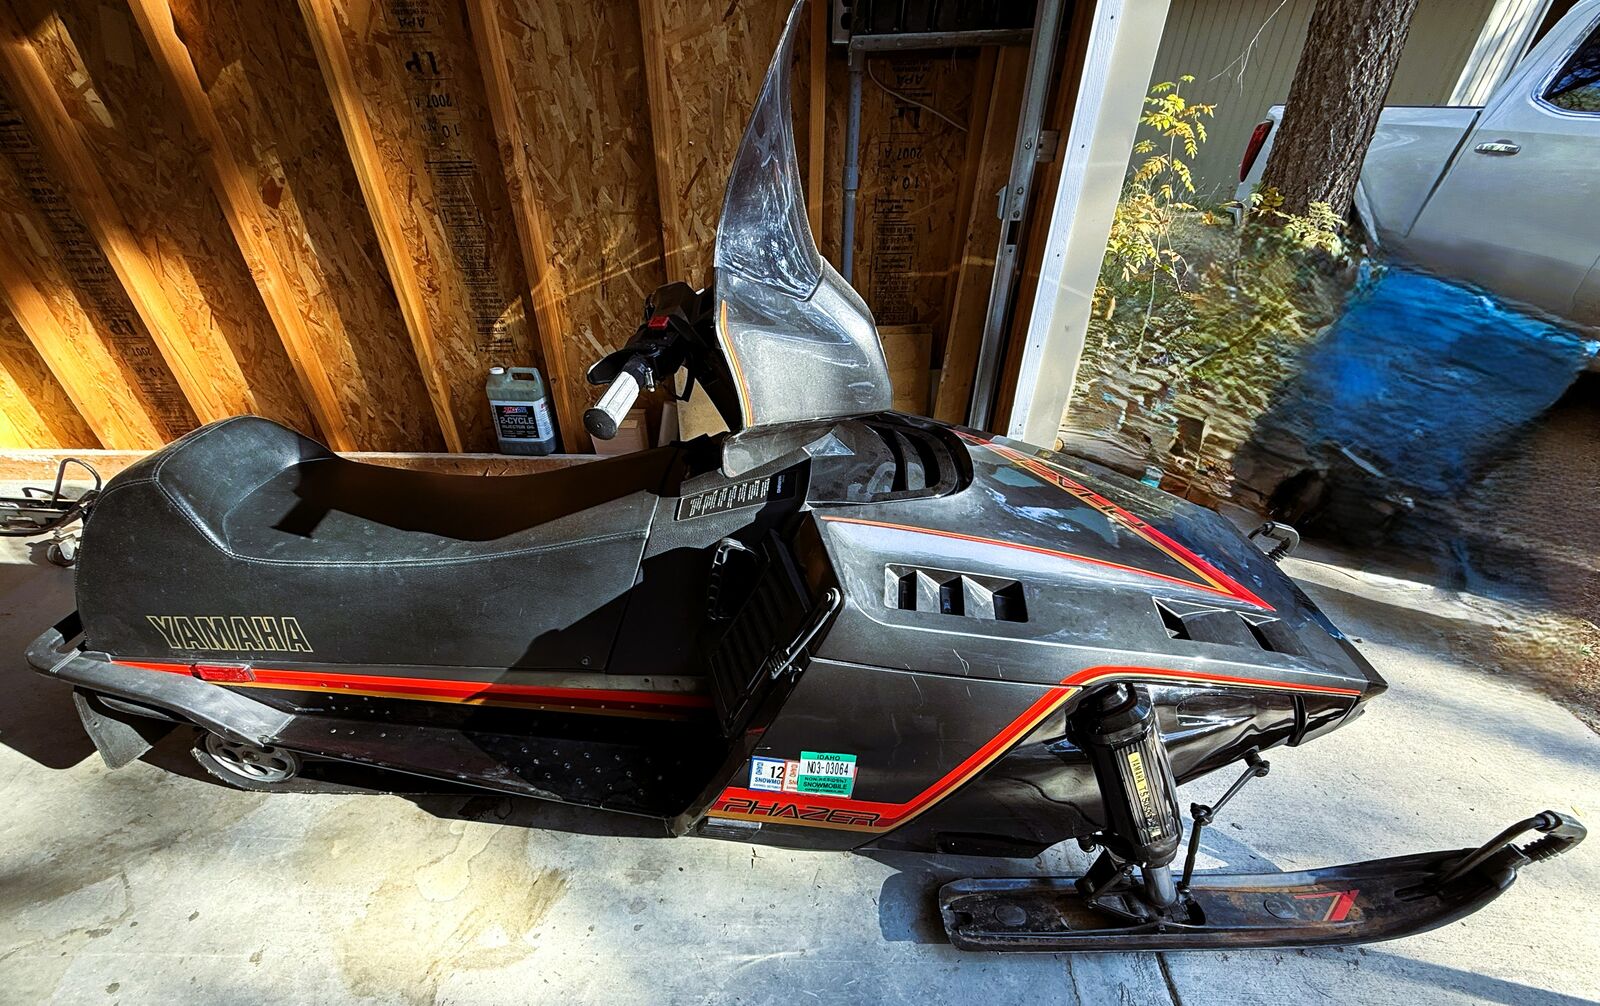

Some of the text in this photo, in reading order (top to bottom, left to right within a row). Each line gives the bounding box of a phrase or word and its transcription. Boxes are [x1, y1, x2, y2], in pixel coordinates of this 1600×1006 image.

[500, 416, 535, 425] 2-CYCLE
[145, 615, 314, 653] YAMAHA
[770, 765, 785, 779] 12
[1131, 758, 1145, 783] YAMAHA
[754, 777, 783, 785] SNOWMO
[803, 782, 848, 790] SNOWMOBILE
[723, 797, 881, 827] PHAZER
